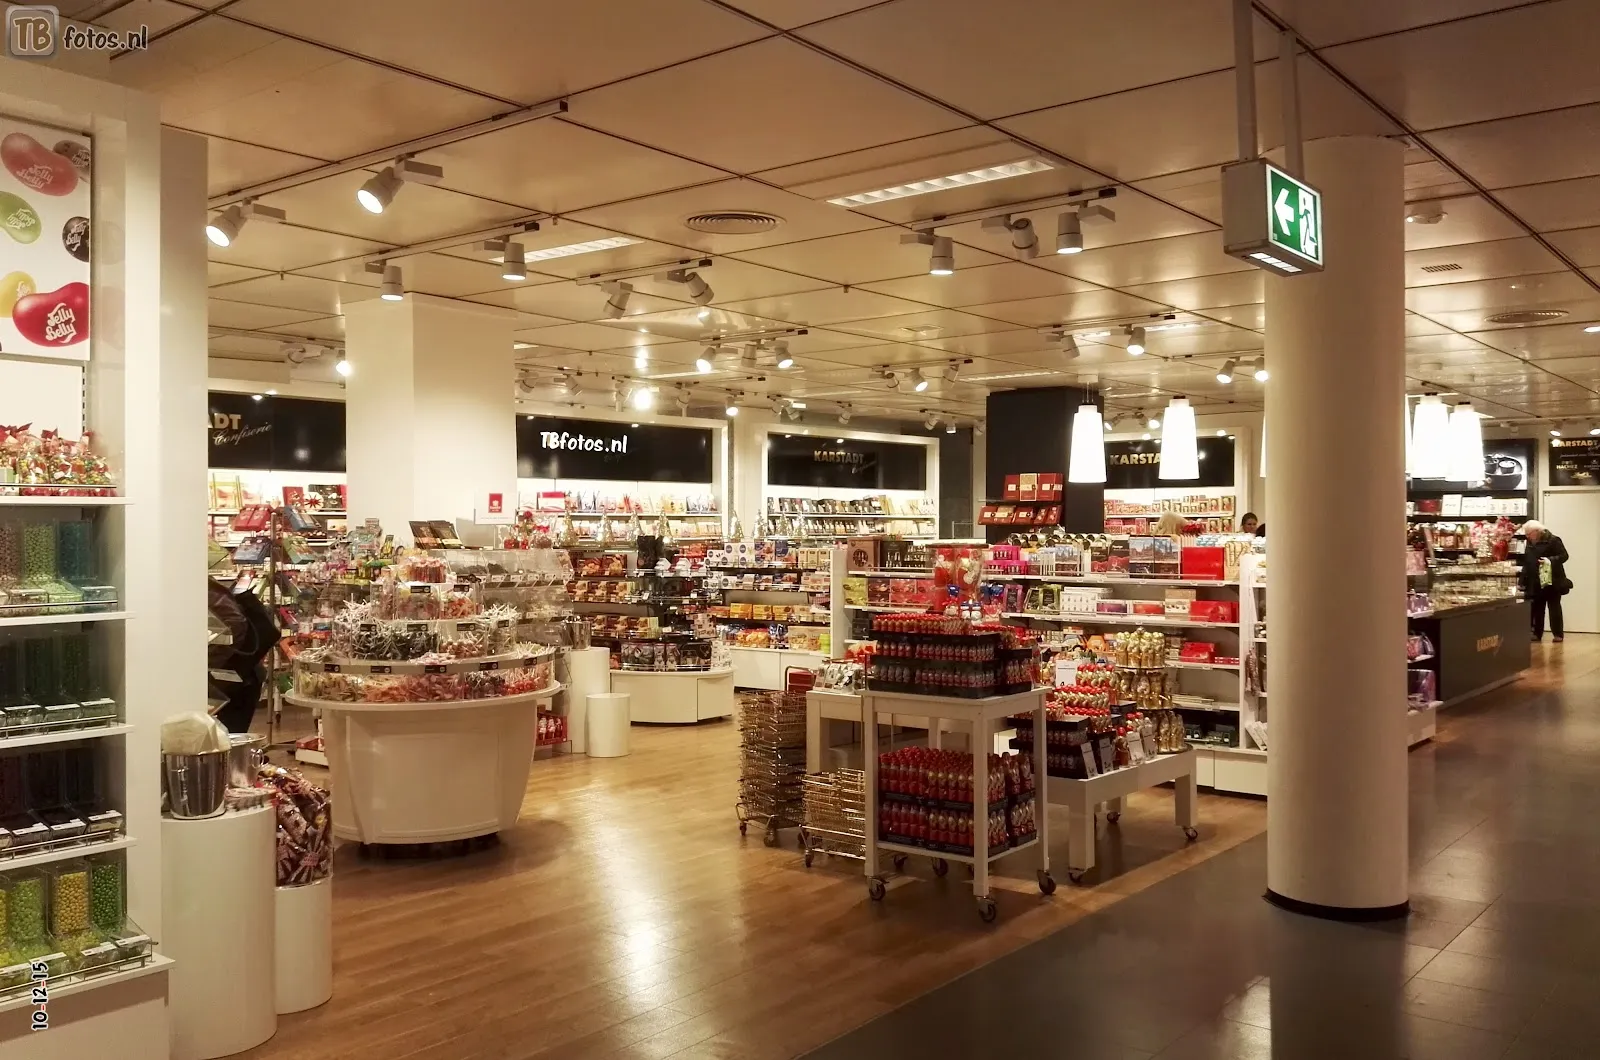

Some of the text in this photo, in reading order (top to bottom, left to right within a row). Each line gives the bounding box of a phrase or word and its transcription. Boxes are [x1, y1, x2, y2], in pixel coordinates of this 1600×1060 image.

[28, 164, 54, 185] Jelly
[47, 302, 76, 326] Jelly
[45, 323, 77, 343] Belly
[1553, 440, 1598, 448] ARSTADT
[814, 450, 864, 464] KARSTADT
